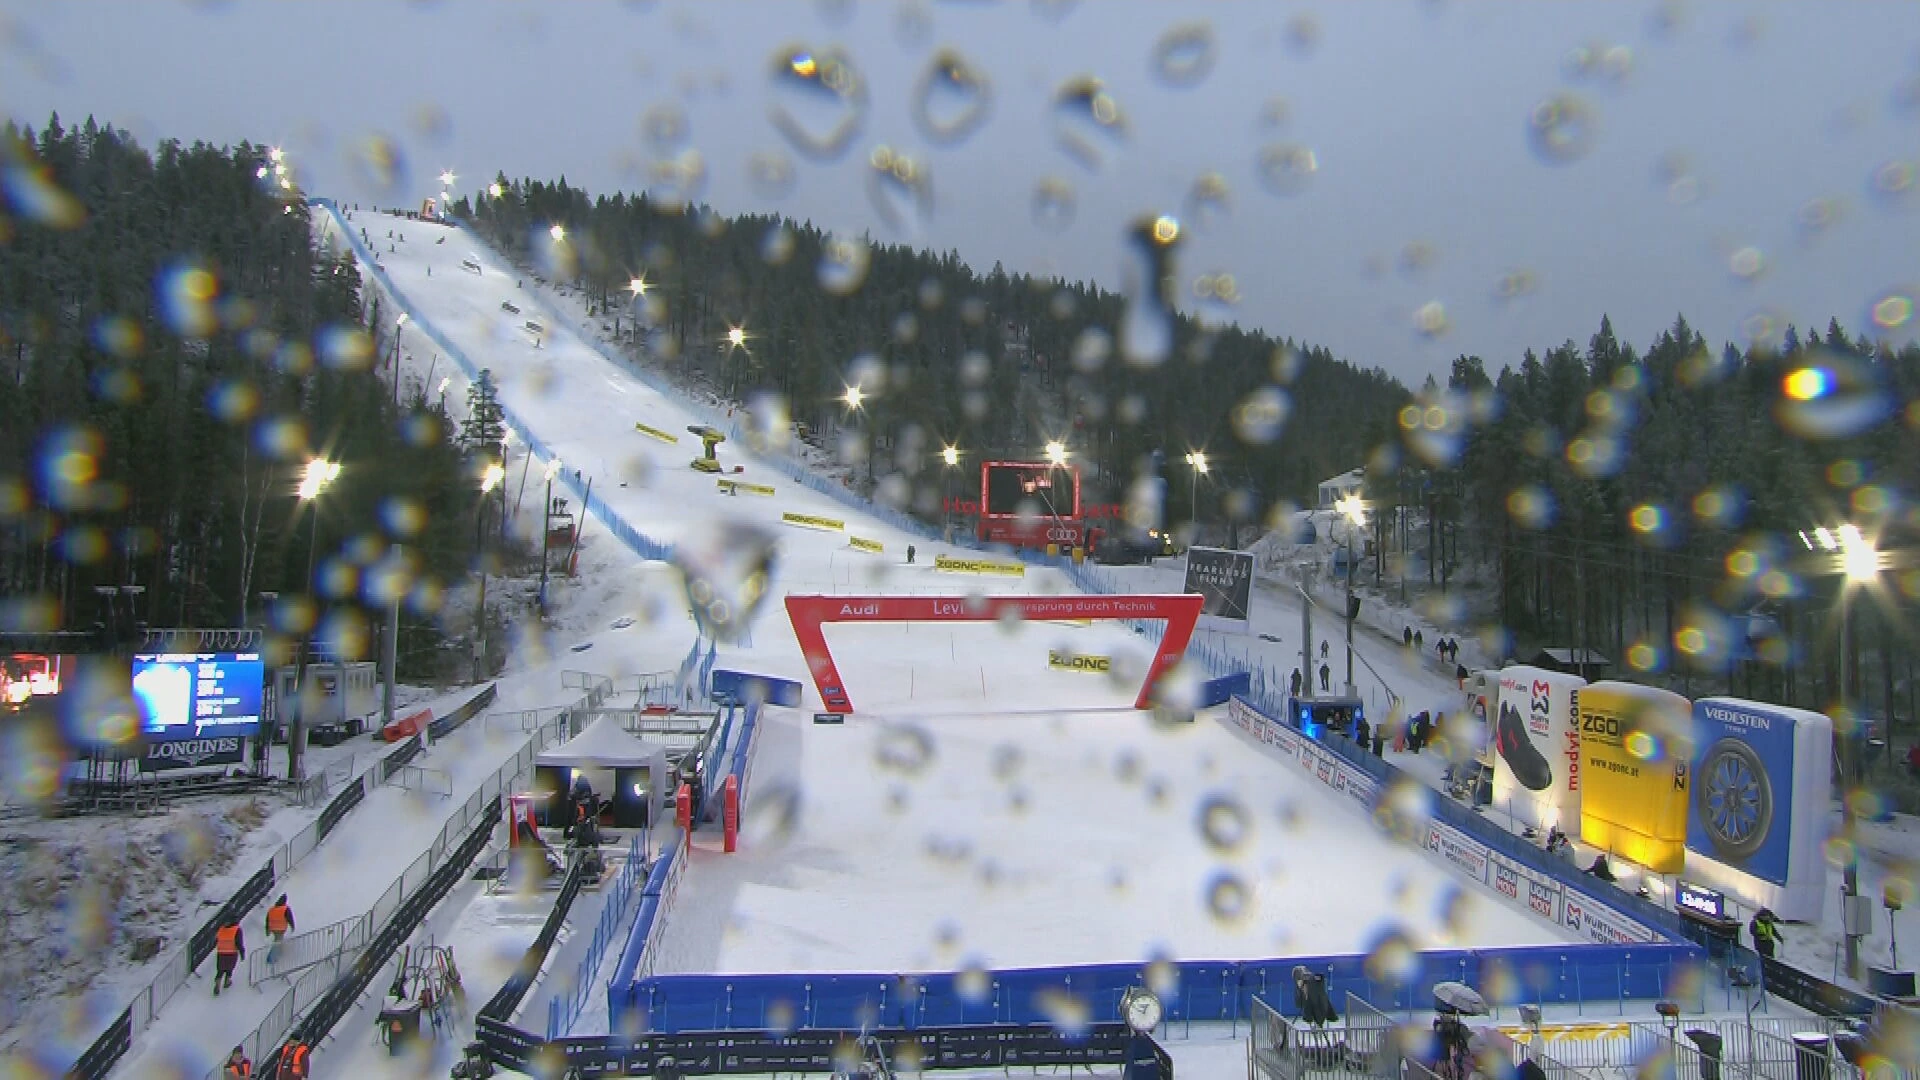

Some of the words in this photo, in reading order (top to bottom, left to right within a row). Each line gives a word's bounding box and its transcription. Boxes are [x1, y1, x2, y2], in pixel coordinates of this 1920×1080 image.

[839, 603, 879, 615] Audi
[933, 599, 964, 615] Levi
[1076, 602, 1110, 611] durch
[1114, 601, 1156, 611] Technik
[1582, 713, 1623, 737] ZGO
[1705, 706, 1770, 730] VREDESTEIN
[148, 738, 238, 759] LONGINES
[1564, 689, 1579, 791] modyf.com
